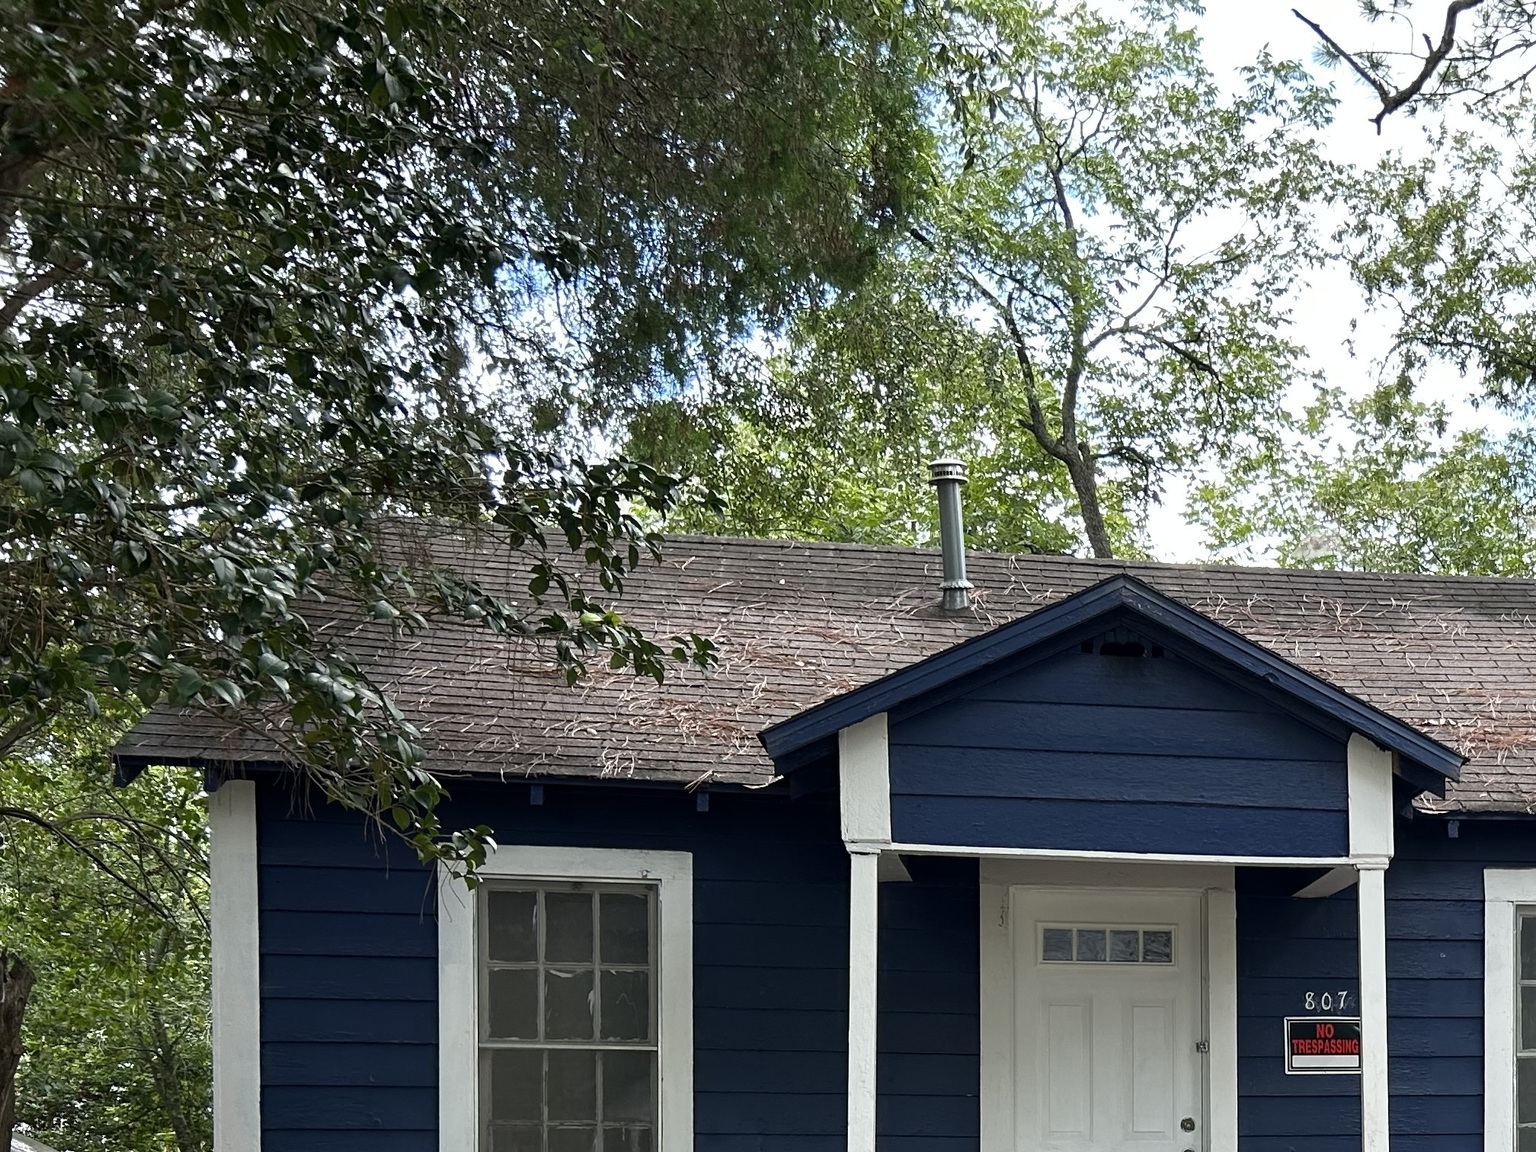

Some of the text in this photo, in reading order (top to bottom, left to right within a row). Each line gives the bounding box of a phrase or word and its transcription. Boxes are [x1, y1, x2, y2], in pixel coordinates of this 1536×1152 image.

[1305, 991, 1348, 1010] 807
[1316, 1024, 1334, 1038] NO
[1292, 1039, 1359, 1054] TRESPASSING
